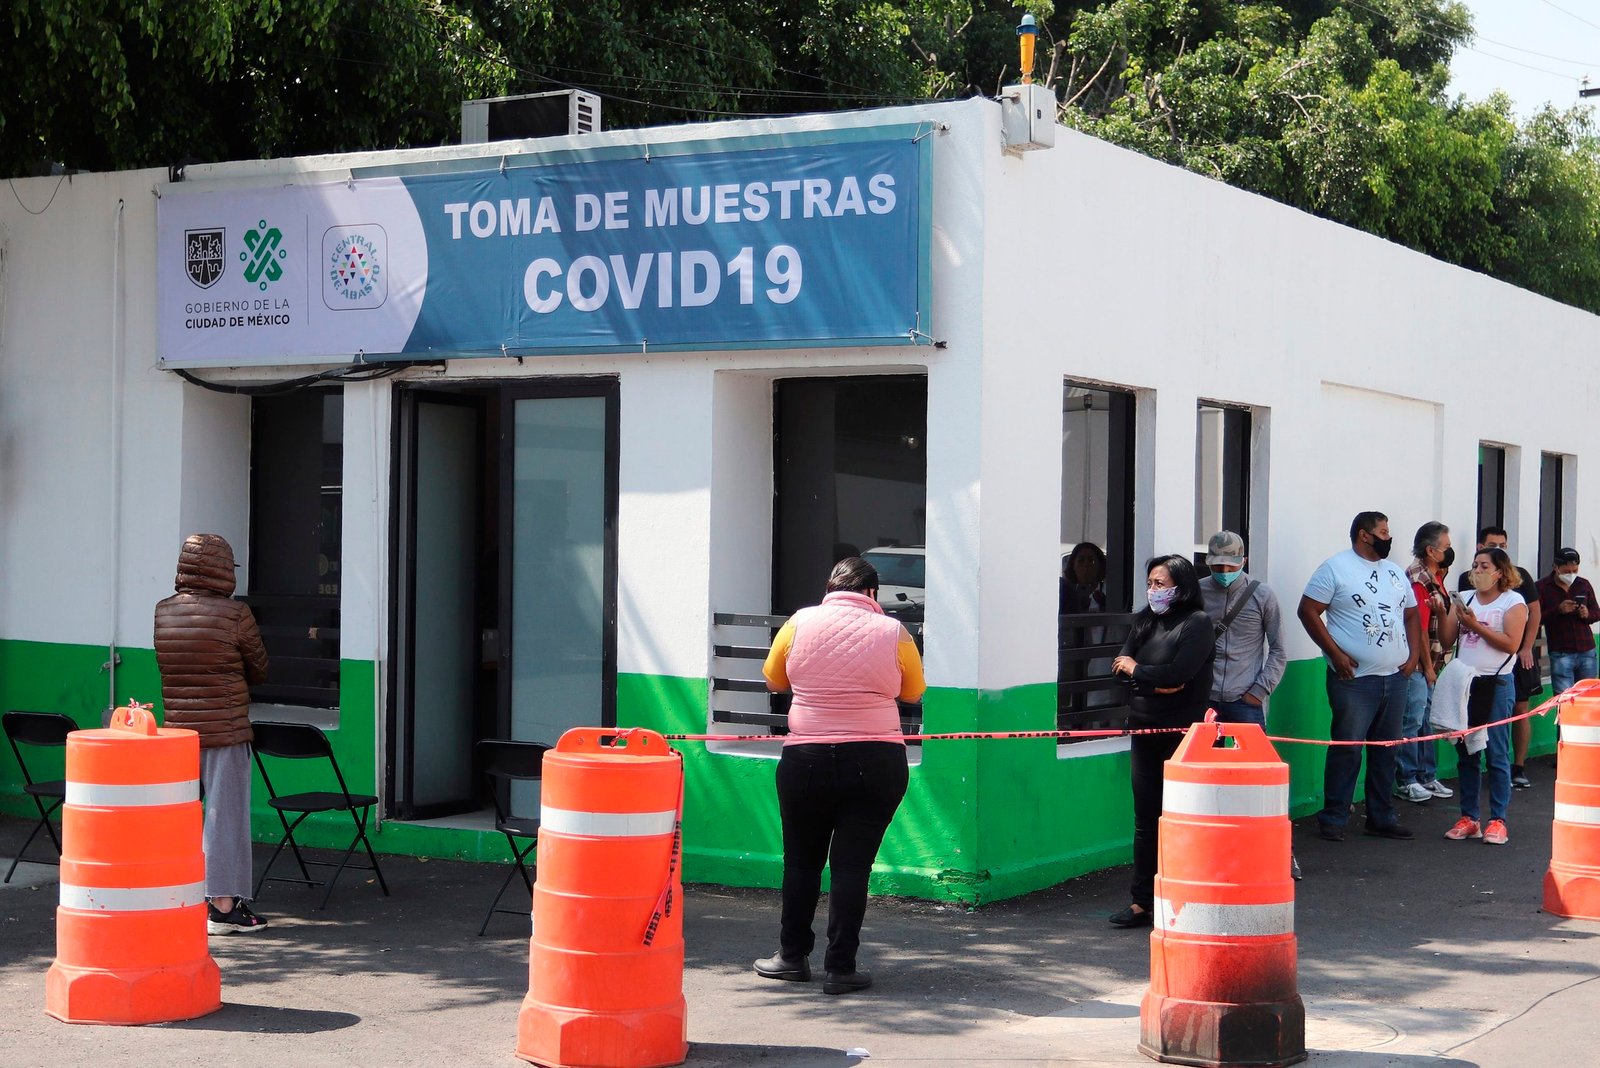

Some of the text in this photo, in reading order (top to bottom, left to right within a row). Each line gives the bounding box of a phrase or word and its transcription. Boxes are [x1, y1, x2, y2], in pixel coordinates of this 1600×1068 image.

[444, 173, 897, 240] TOMA DE MUESTRAS
[331, 234, 377, 263] CENTRAL
[330, 264, 380, 300] DE ABASTO
[523, 244, 804, 315] COVID19
[185, 298, 290, 314] GOBIERNO DE LA
[185, 312, 290, 329] CIUDAD DE MÉXICO
